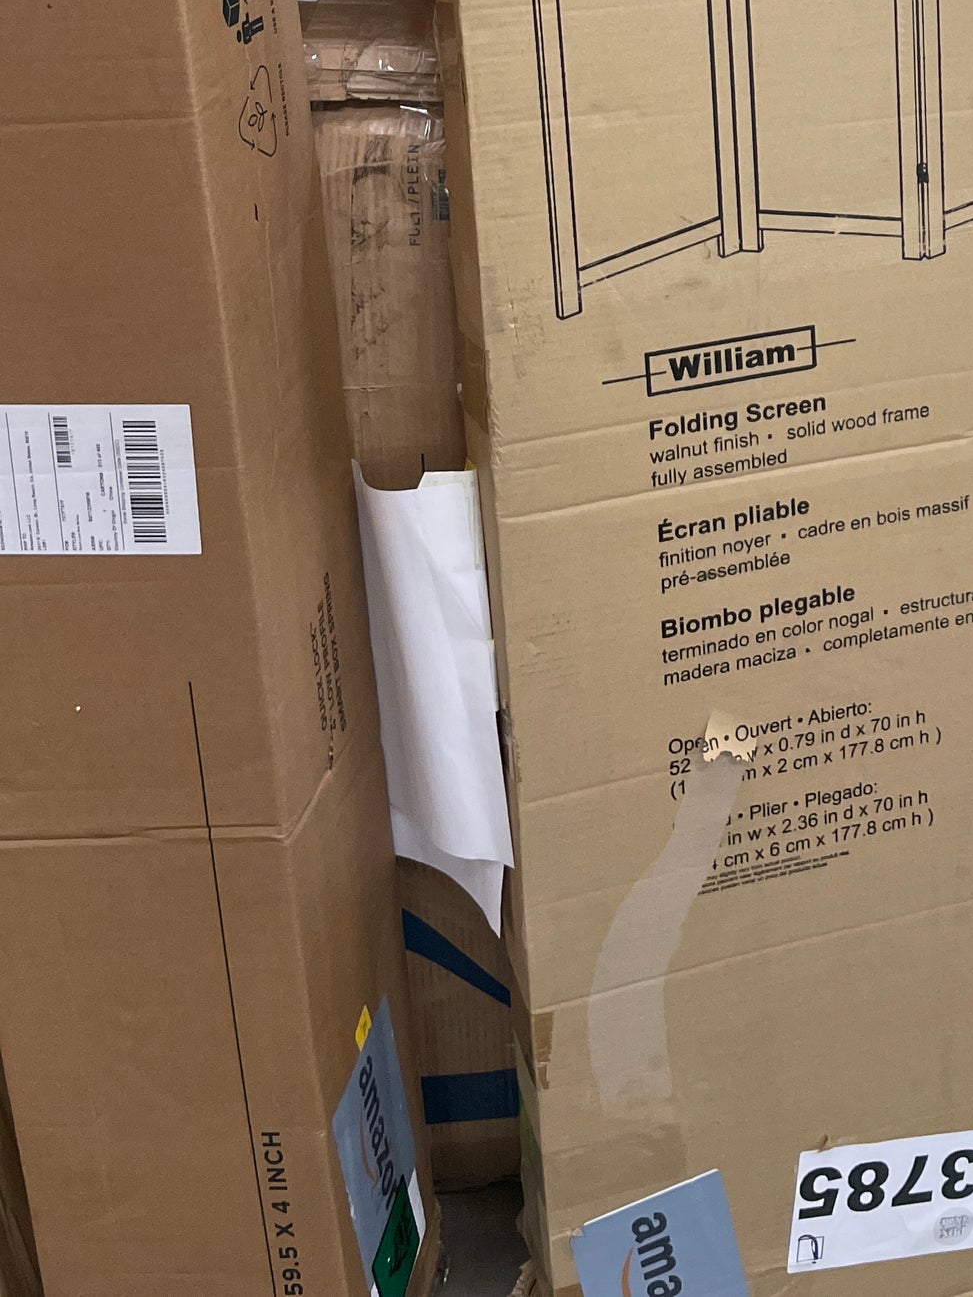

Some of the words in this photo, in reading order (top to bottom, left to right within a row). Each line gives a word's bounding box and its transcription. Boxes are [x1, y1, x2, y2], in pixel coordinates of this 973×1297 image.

[270, 4, 276, 12] A
[271, 19, 279, 35] USE
[277, 62, 287, 109] RECYCLE
[668, 343, 796, 382] William
[648, 410, 738, 440] Folding
[745, 396, 827, 423] Screen
[649, 440, 709, 465] walnut
[713, 430, 760, 453] finish
[786, 420, 827, 440] solid
[830, 414, 878, 434] wood
[881, 403, 931, 425] frame
[650, 467, 688, 488] fully
[692, 449, 789, 481] assembled
[657, 515, 727, 544] Écran
[733, 498, 811, 533] pliable
[659, 544, 717, 569] finition
[721, 532, 773, 560] noyer
[796, 518, 847, 540] cadre
[849, 515, 872, 531] en
[875, 506, 912, 527] bois
[915, 494, 971, 519] massif
[660, 550, 791, 594] pré-assemblée
[323, 571, 336, 634] SPRING
[660, 604, 753, 640] Biombo
[758, 585, 857, 624] plegable
[317, 599, 329, 672] PROFILE
[330, 633, 341, 674] BOX
[661, 631, 750, 664] terminado
[754, 628, 777, 645] en
[781, 619, 823, 640] color
[827, 606, 875, 632] nogal
[662, 657, 731, 687] madera
[735, 643, 798, 672] maciza
[821, 615, 950, 653] completamente
[316, 676, 328, 731] QUICK
[325, 672, 336, 711] LOW
[335, 675, 347, 733] SMART
[734, 715, 793, 742] Ouvert
[806, 701, 874, 726] Abierto:
[763, 743, 773, 755] x
[778, 731, 816, 753] 0.79
[820, 728, 835, 744] in
[840, 724, 851, 739] d
[855, 725, 866, 736] x
[870, 716, 892, 734] 70
[895, 713, 911, 729] in
[914, 709, 926, 725] h
[727, 830, 743, 846] in
[747, 828, 763, 842] w
[766, 824, 777, 837] x
[781, 812, 819, 835] 2.36
[823, 808, 839, 824] in
[843, 805, 854, 821] d
[857, 805, 869, 818] x
[873, 797, 895, 815] 70
[898, 793, 913, 809] in
[917, 789, 929, 805] h
[749, 800, 789, 821] Plier
[804, 782, 878, 809] Plegado:
[723, 851, 750, 869] cm
[754, 848, 766, 860] x
[769, 842, 781, 858] 6
[785, 837, 812, 854] cm
[816, 834, 827, 847] x
[831, 820, 878, 844] 177.8
[881, 816, 907, 833] cm
[910, 810, 923, 826] h
[261, 1130, 289, 1192] INCH
[271, 1199, 291, 1215] 4
[274, 1221, 296, 1238] X
[282, 1245, 304, 1297] 59.5
